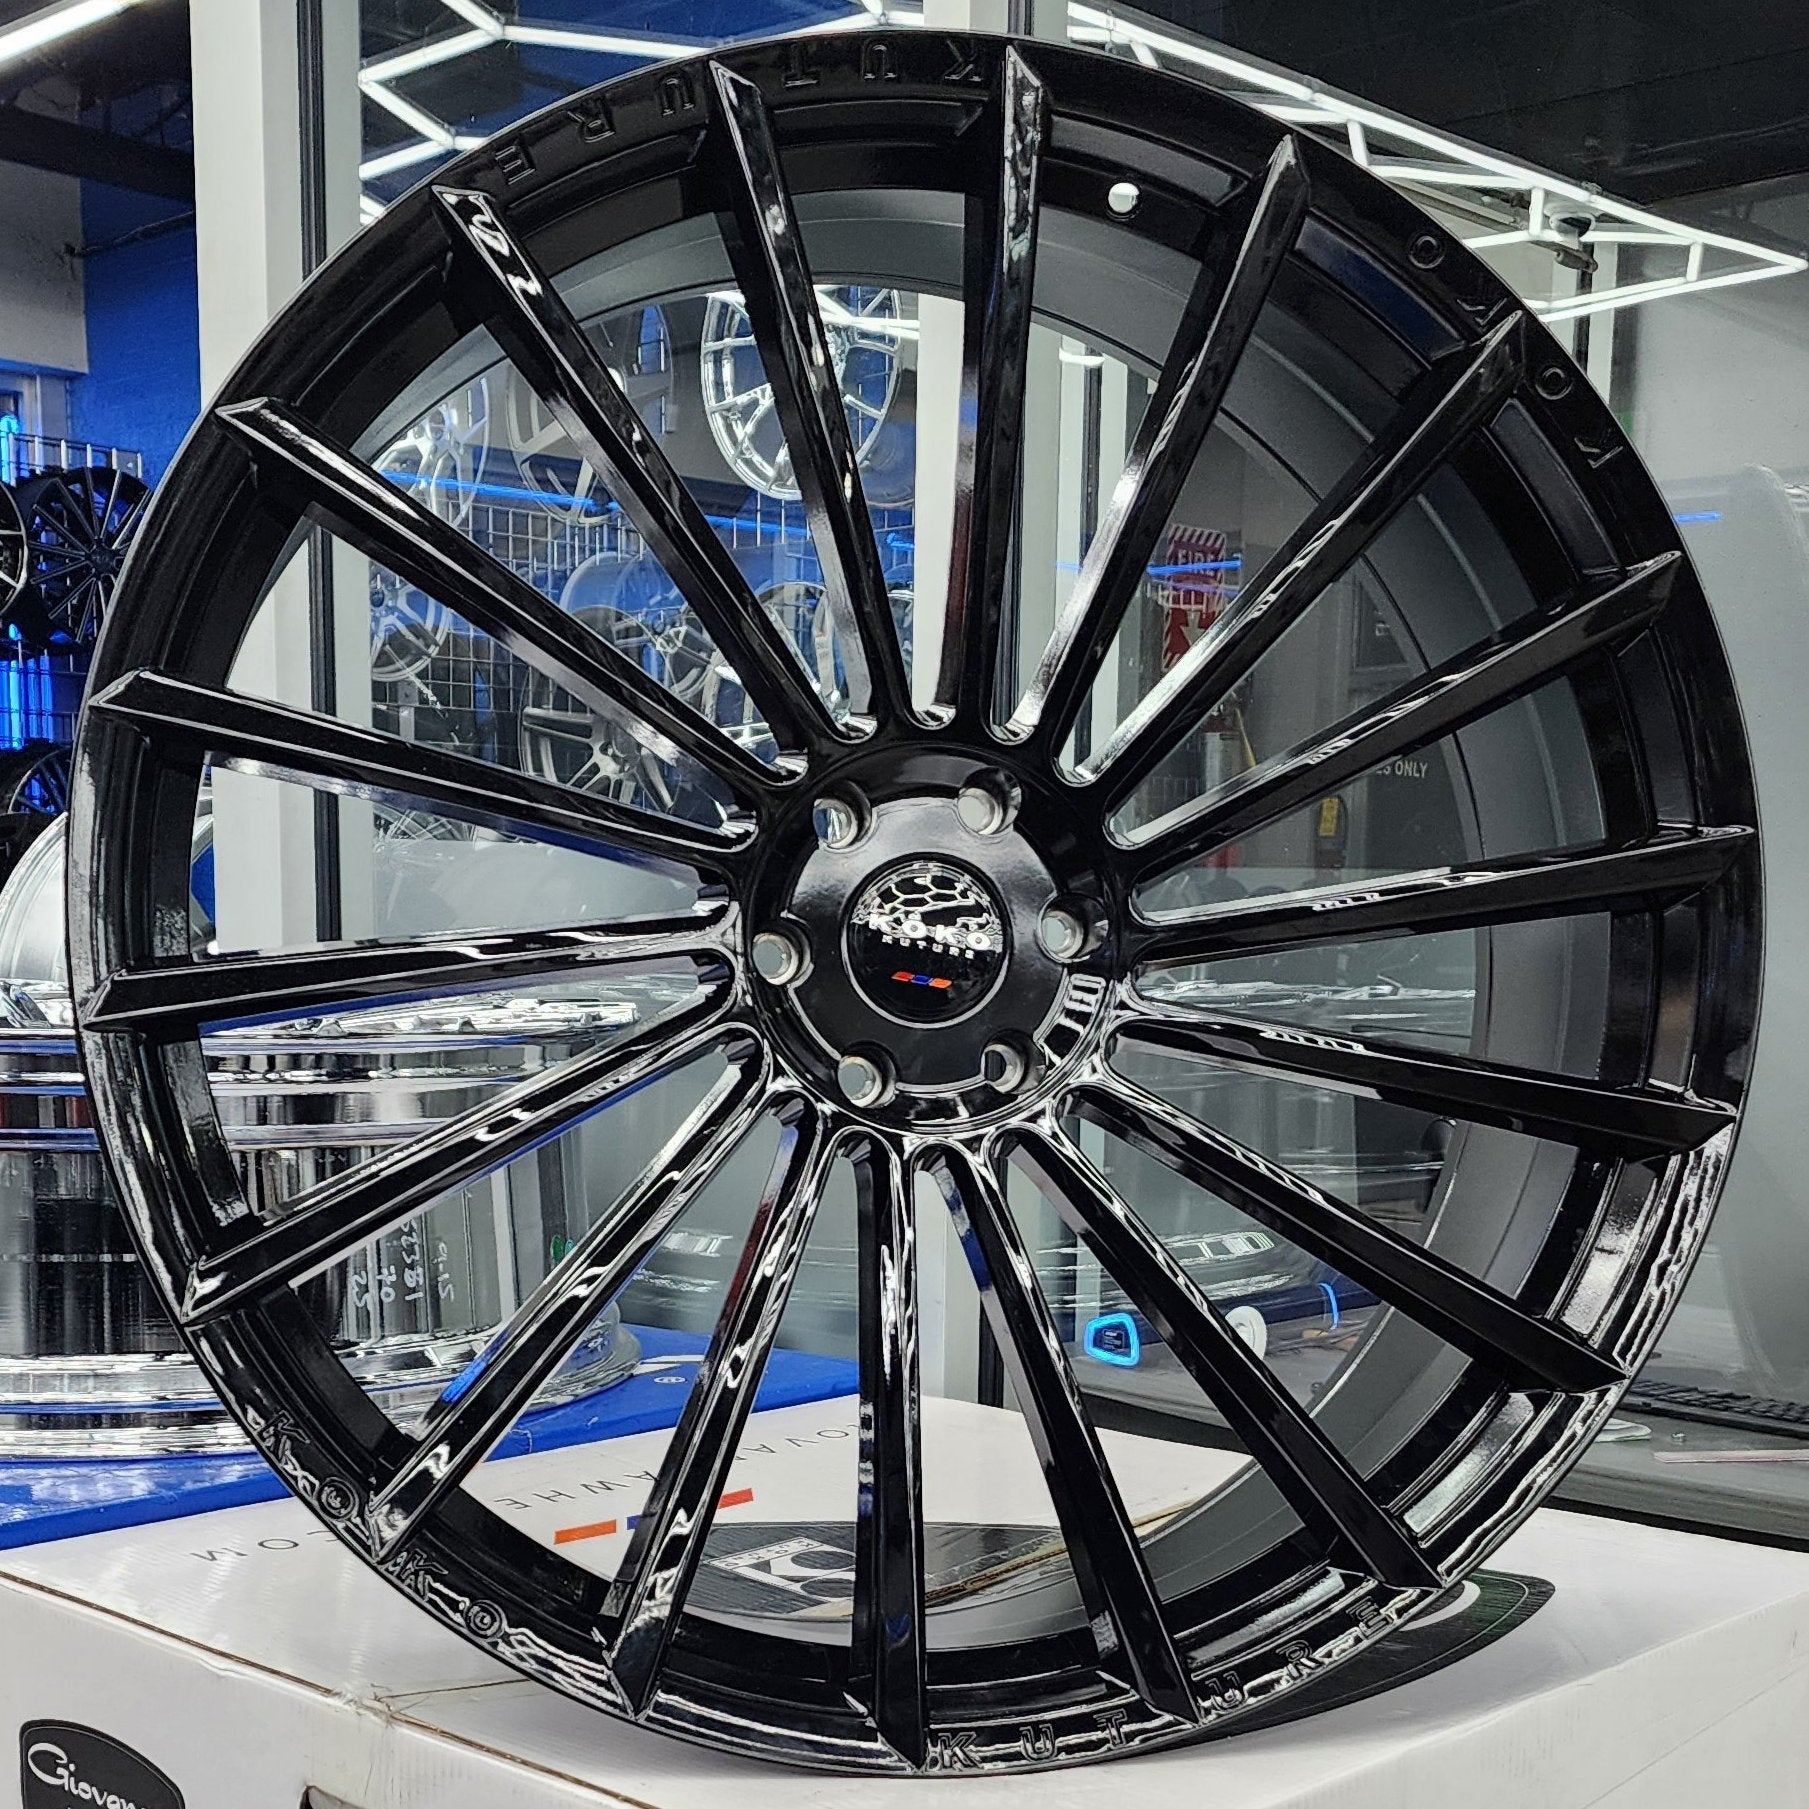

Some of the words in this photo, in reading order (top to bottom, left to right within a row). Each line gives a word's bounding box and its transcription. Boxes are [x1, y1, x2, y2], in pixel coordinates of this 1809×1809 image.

[1178, 549, 1219, 577] FIRE
[1395, 760, 1427, 778] ONLY
[27, 1742, 146, 1809] Giovan
